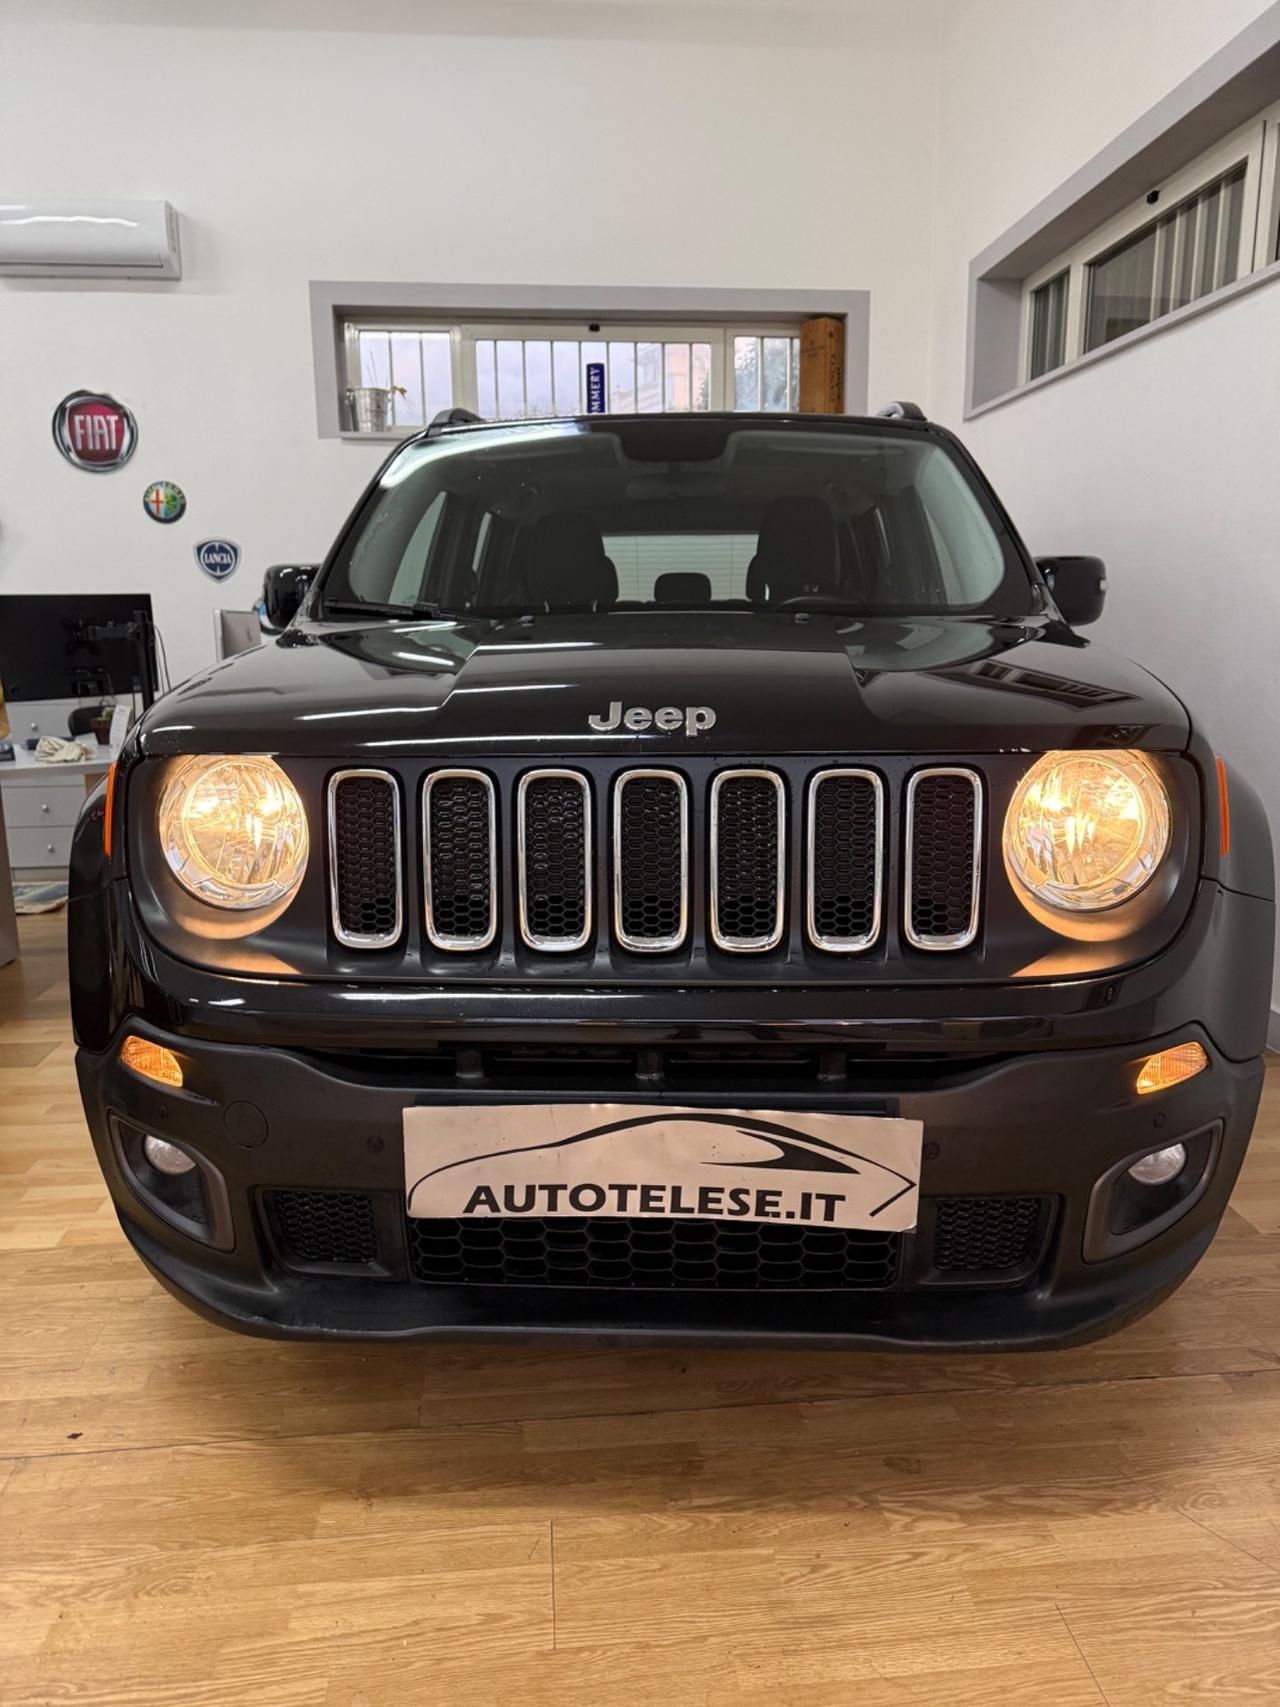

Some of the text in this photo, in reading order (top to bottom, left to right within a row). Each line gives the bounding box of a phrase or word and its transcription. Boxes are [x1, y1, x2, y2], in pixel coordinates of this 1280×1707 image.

[590, 367, 601, 414] MMERY
[74, 415, 119, 450] FIAT
[204, 552, 232, 564] LANCIA
[588, 701, 716, 736] Jeep
[463, 1183, 846, 1222] AUTOTELESE.IT
